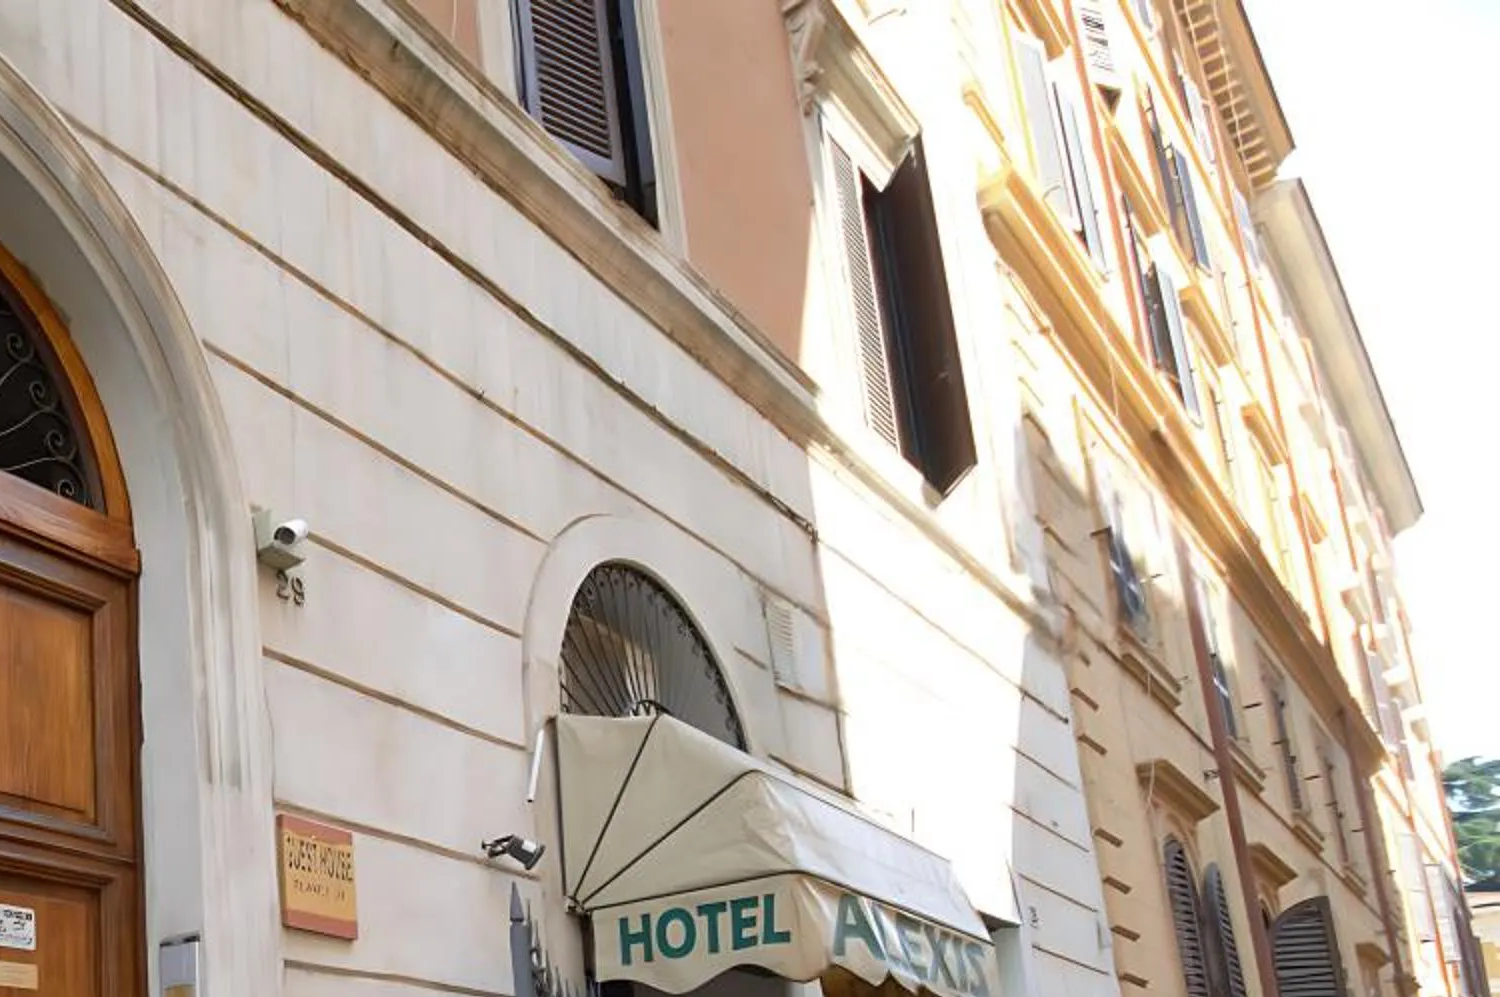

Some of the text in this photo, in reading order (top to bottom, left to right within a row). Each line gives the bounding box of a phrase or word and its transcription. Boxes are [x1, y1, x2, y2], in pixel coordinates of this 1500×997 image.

[276, 568, 305, 607] 29
[320, 846, 353, 882] HOUSE
[619, 894, 791, 966] HOTEL
[833, 894, 991, 997] ALEXIS
